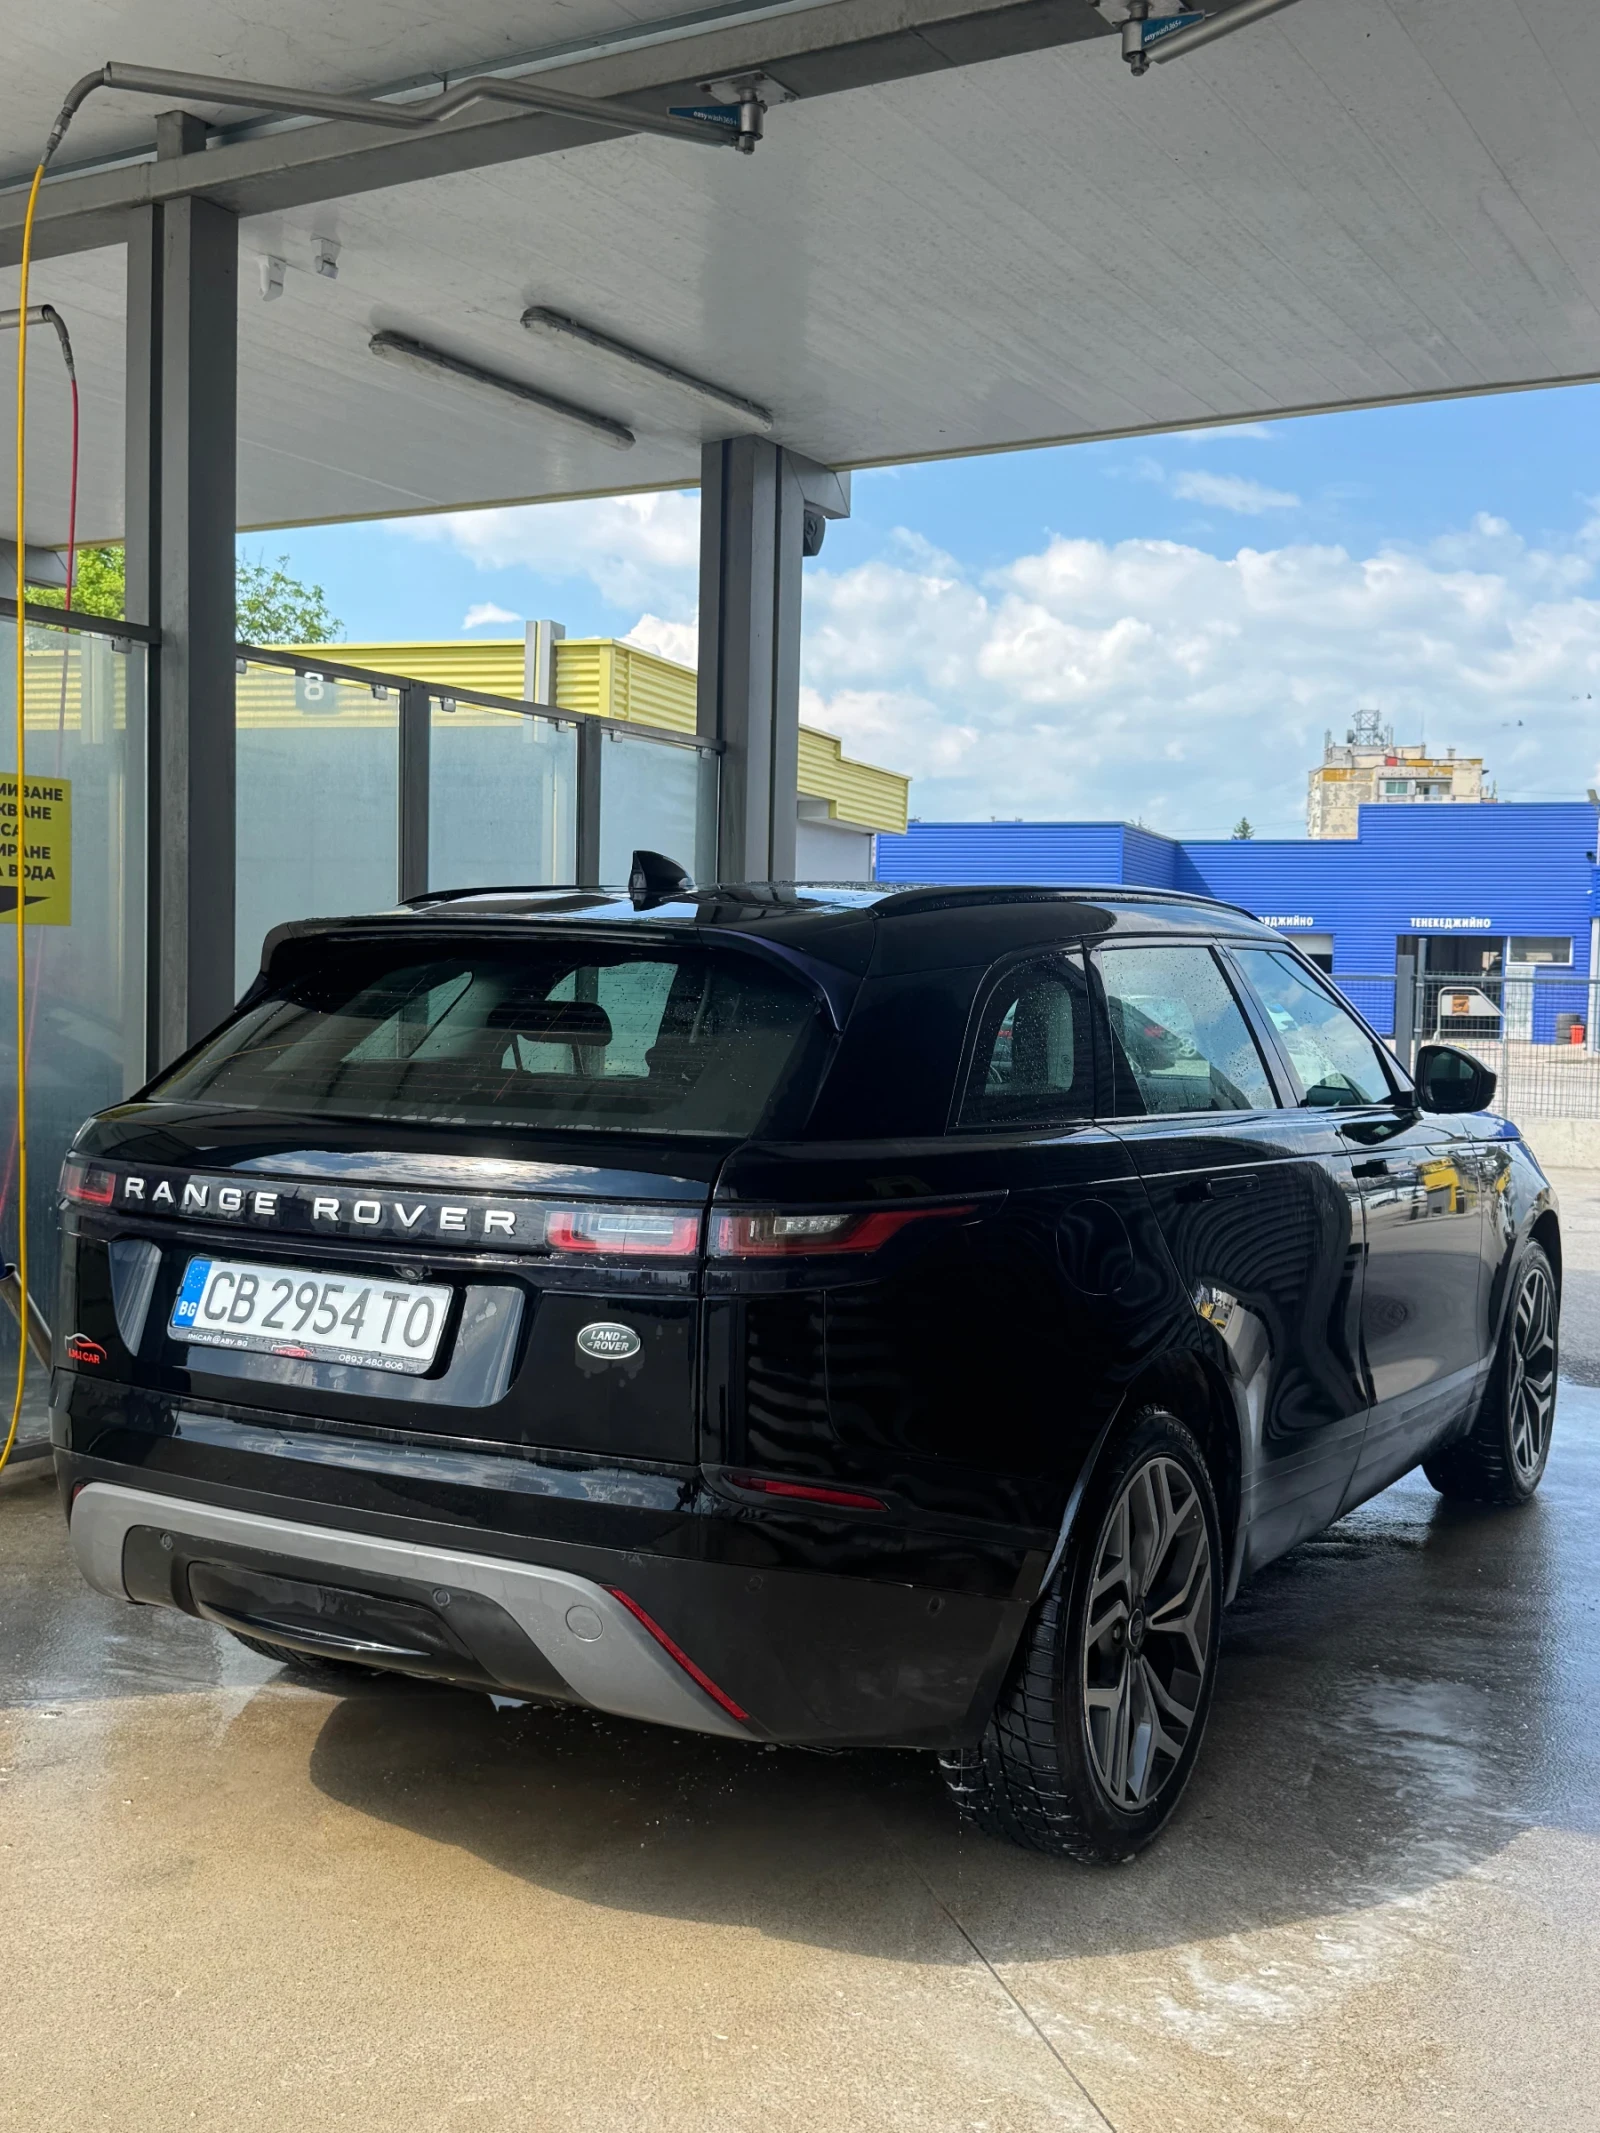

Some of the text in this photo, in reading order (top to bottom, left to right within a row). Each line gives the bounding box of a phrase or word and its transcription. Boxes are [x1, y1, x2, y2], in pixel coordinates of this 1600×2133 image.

[303, 671, 324, 701] 8
[1410, 916, 1491, 929] ТЕНЕКЕДЖИЙНО
[124, 1177, 517, 1235] RANGE ROVER
[178, 1300, 197, 1317] BG
[204, 1271, 260, 1324] CB
[260, 1278, 372, 1340] 2954
[338, 1353, 364, 1364] 0893
